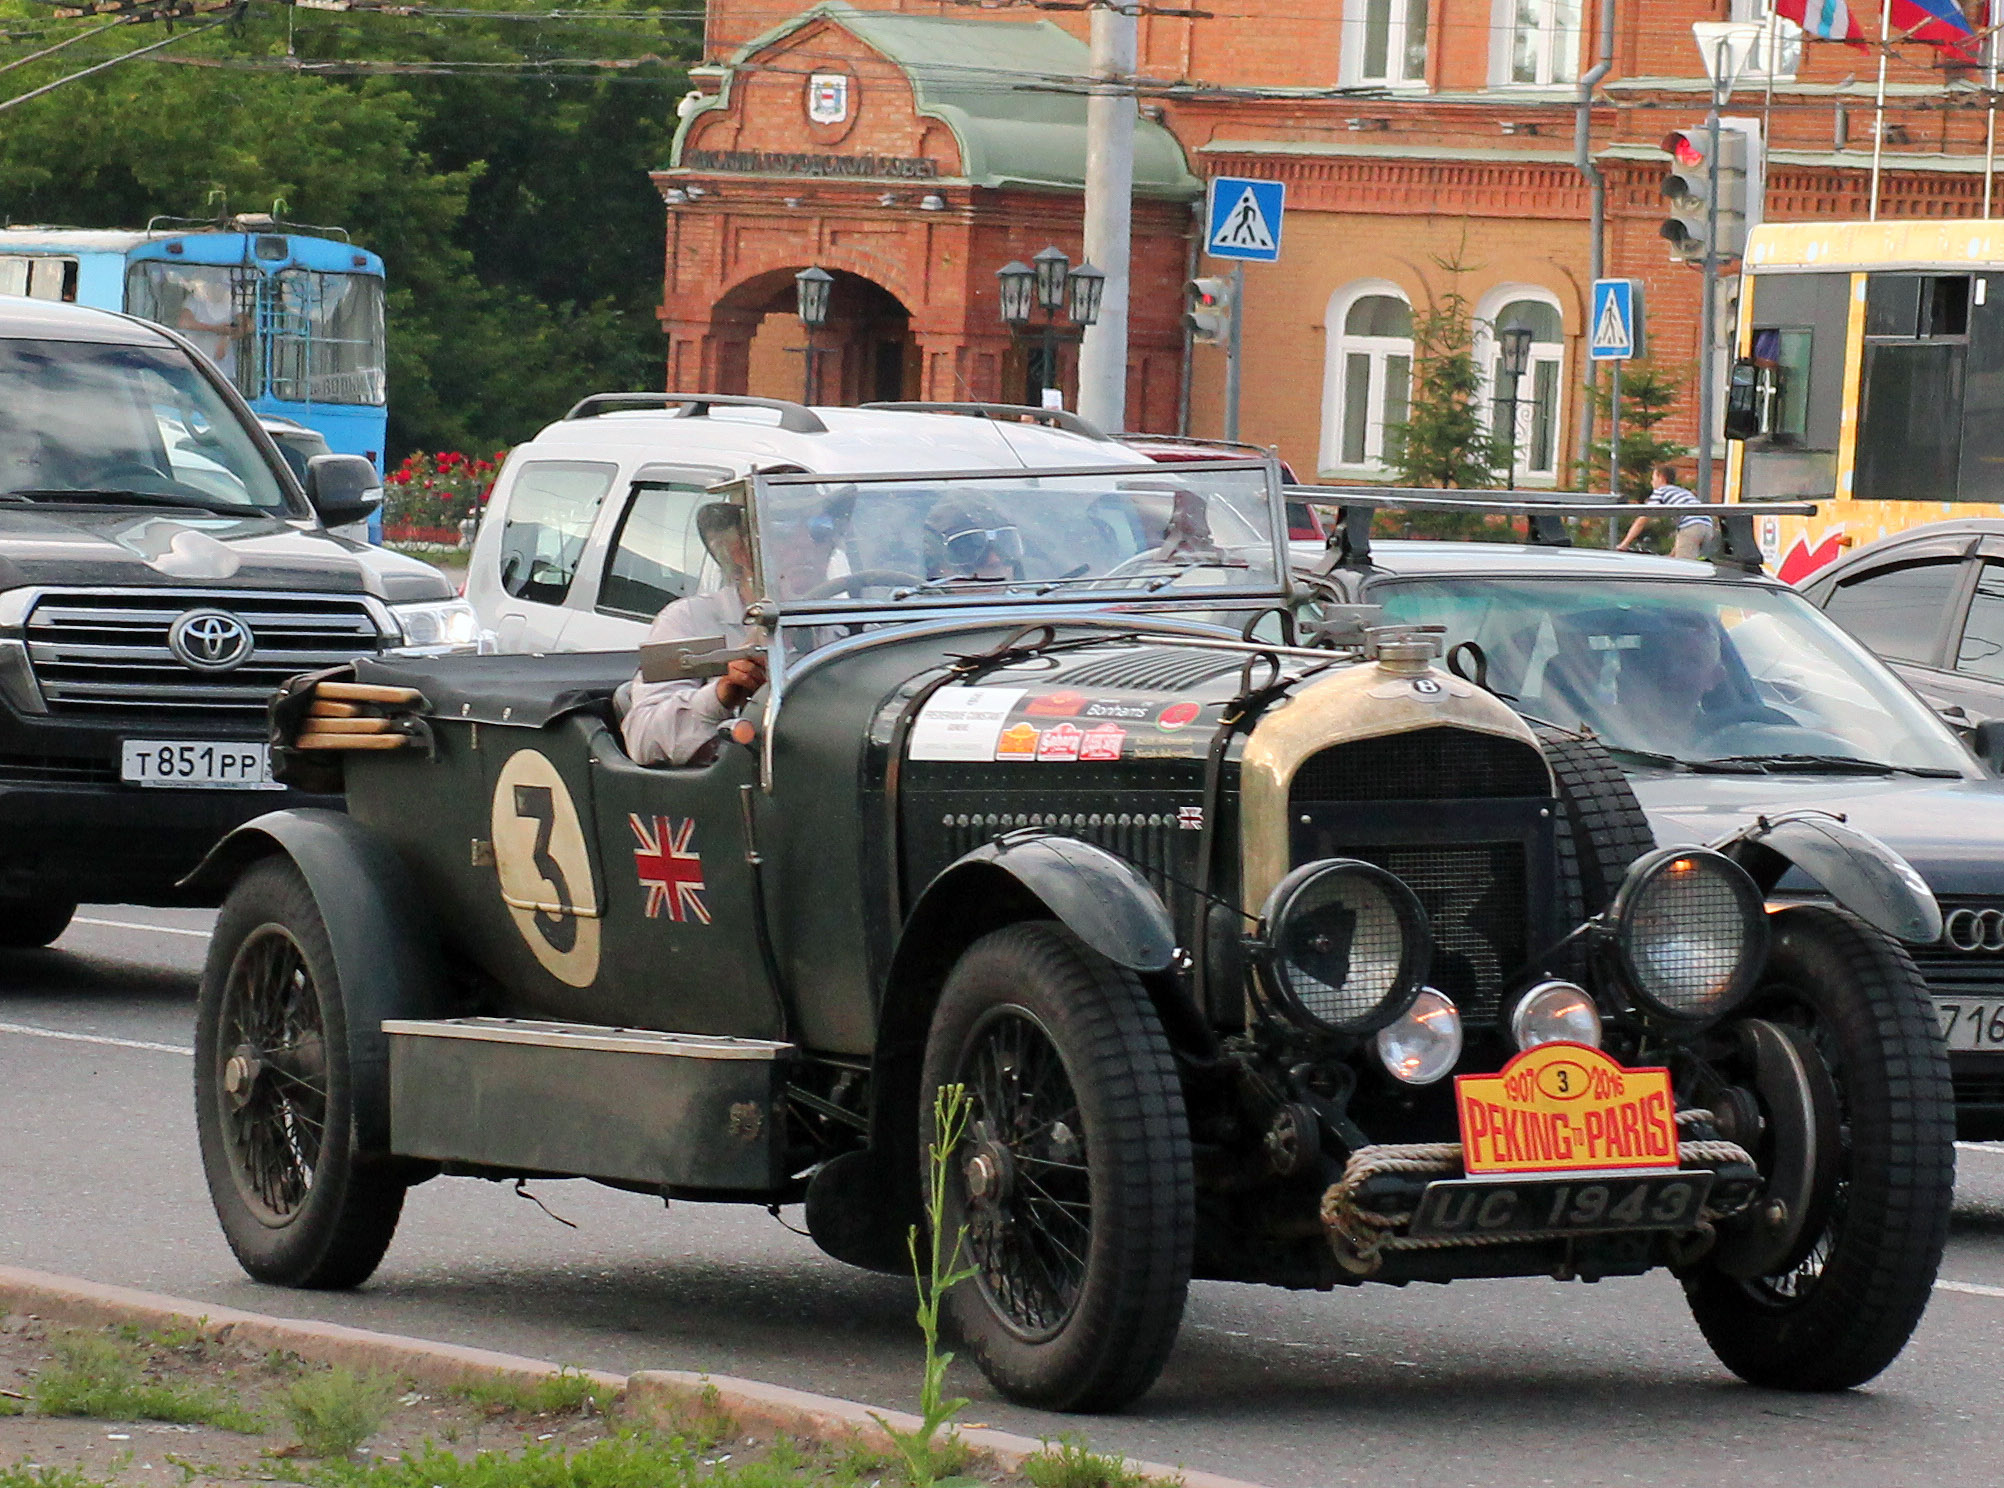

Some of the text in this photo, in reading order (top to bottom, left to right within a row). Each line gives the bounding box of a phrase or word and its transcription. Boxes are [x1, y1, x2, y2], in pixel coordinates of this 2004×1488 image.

[1086, 703, 1149, 718] Bonhams
[513, 784, 578, 954] 3
[1941, 1005, 2004, 1043] 716
[1504, 1065, 1625, 1103] 1907 3 2016
[1466, 1096, 1573, 1163] PEKING
[1585, 1090, 1669, 1159] PARIS
[1431, 1182, 1693, 1228] UC 1943
